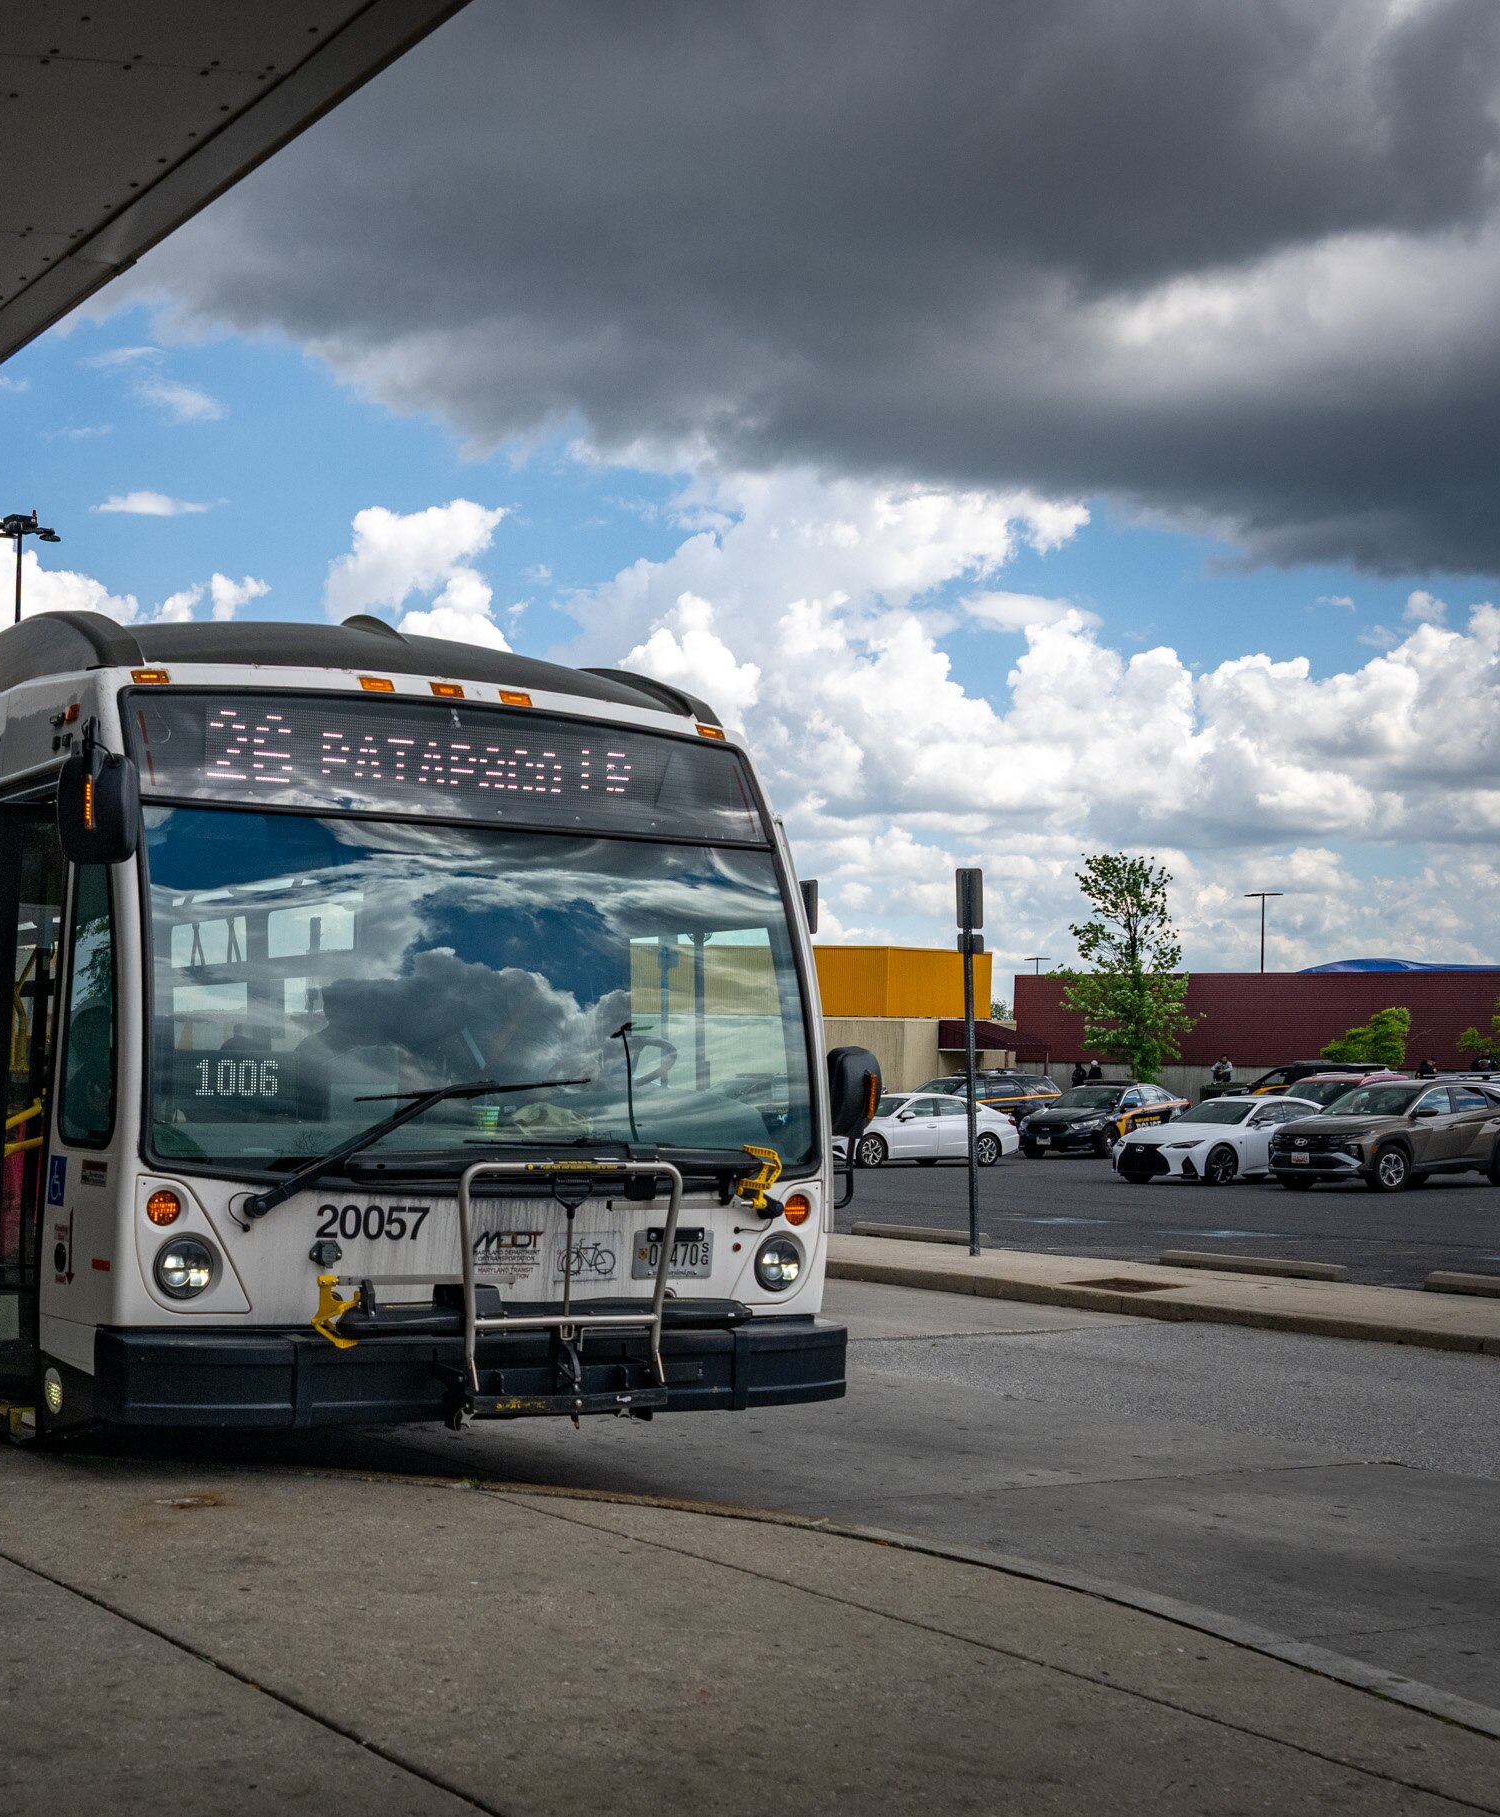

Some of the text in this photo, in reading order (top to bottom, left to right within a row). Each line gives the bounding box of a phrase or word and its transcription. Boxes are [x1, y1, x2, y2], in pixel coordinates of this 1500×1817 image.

[206, 711, 292, 783] 26
[195, 1058, 279, 1097] 1006
[315, 1203, 431, 1242] 20057
[649, 1243, 699, 1266] 0470
